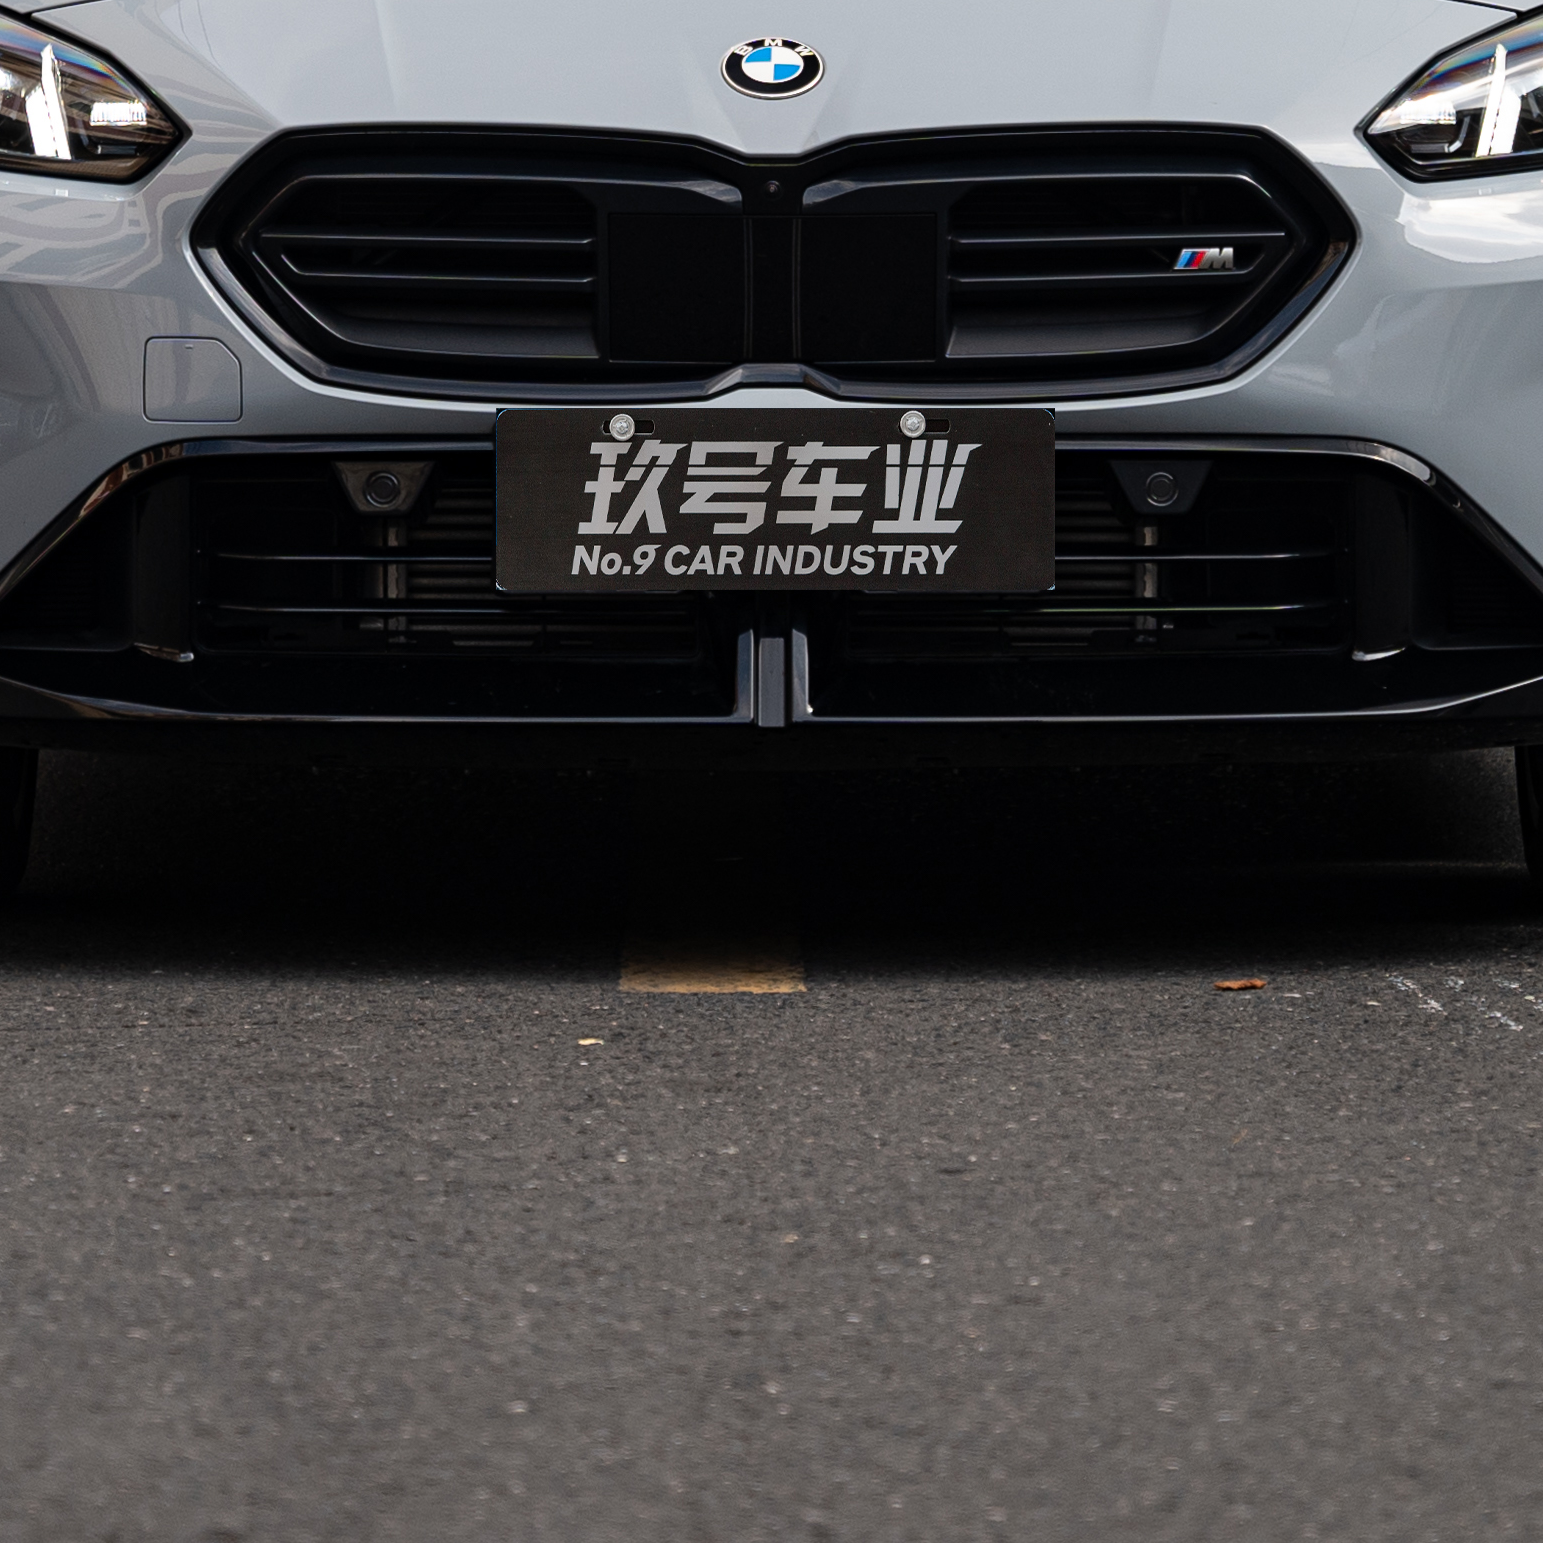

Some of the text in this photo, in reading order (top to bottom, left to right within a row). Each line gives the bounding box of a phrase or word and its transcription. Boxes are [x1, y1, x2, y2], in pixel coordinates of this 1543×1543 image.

[734, 37, 814, 57] BMW
[577, 438, 983, 536] 玖号车业
[571, 544, 959, 576] No.9 CAR INDUSTRY
